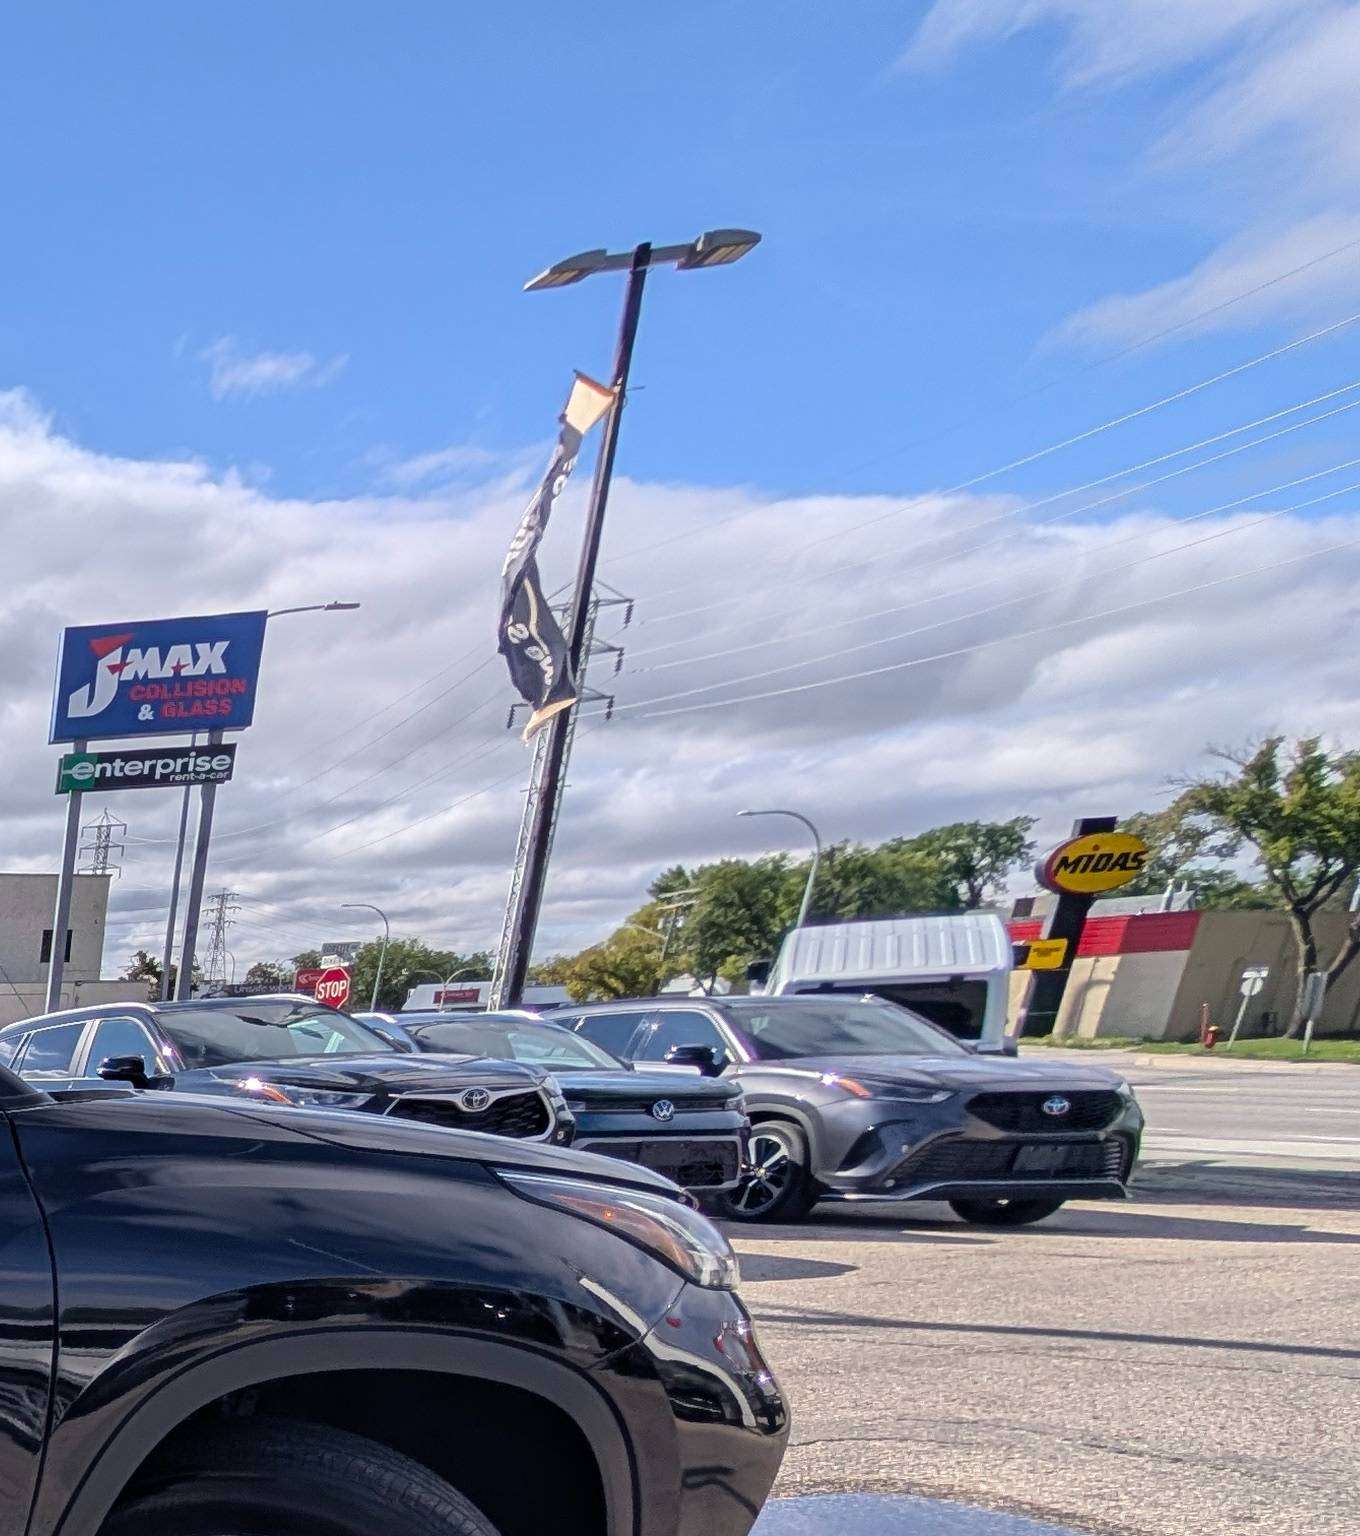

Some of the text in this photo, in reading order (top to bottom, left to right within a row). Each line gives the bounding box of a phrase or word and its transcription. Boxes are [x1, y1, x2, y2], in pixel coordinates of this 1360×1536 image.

[130, 678, 246, 702] COLLISION
[137, 699, 232, 721] & GLASS
[71, 751, 232, 780] enterprise
[169, 770, 230, 782] rent-a-car
[1054, 848, 1149, 876] MIDAS
[318, 980, 347, 999] STOP
